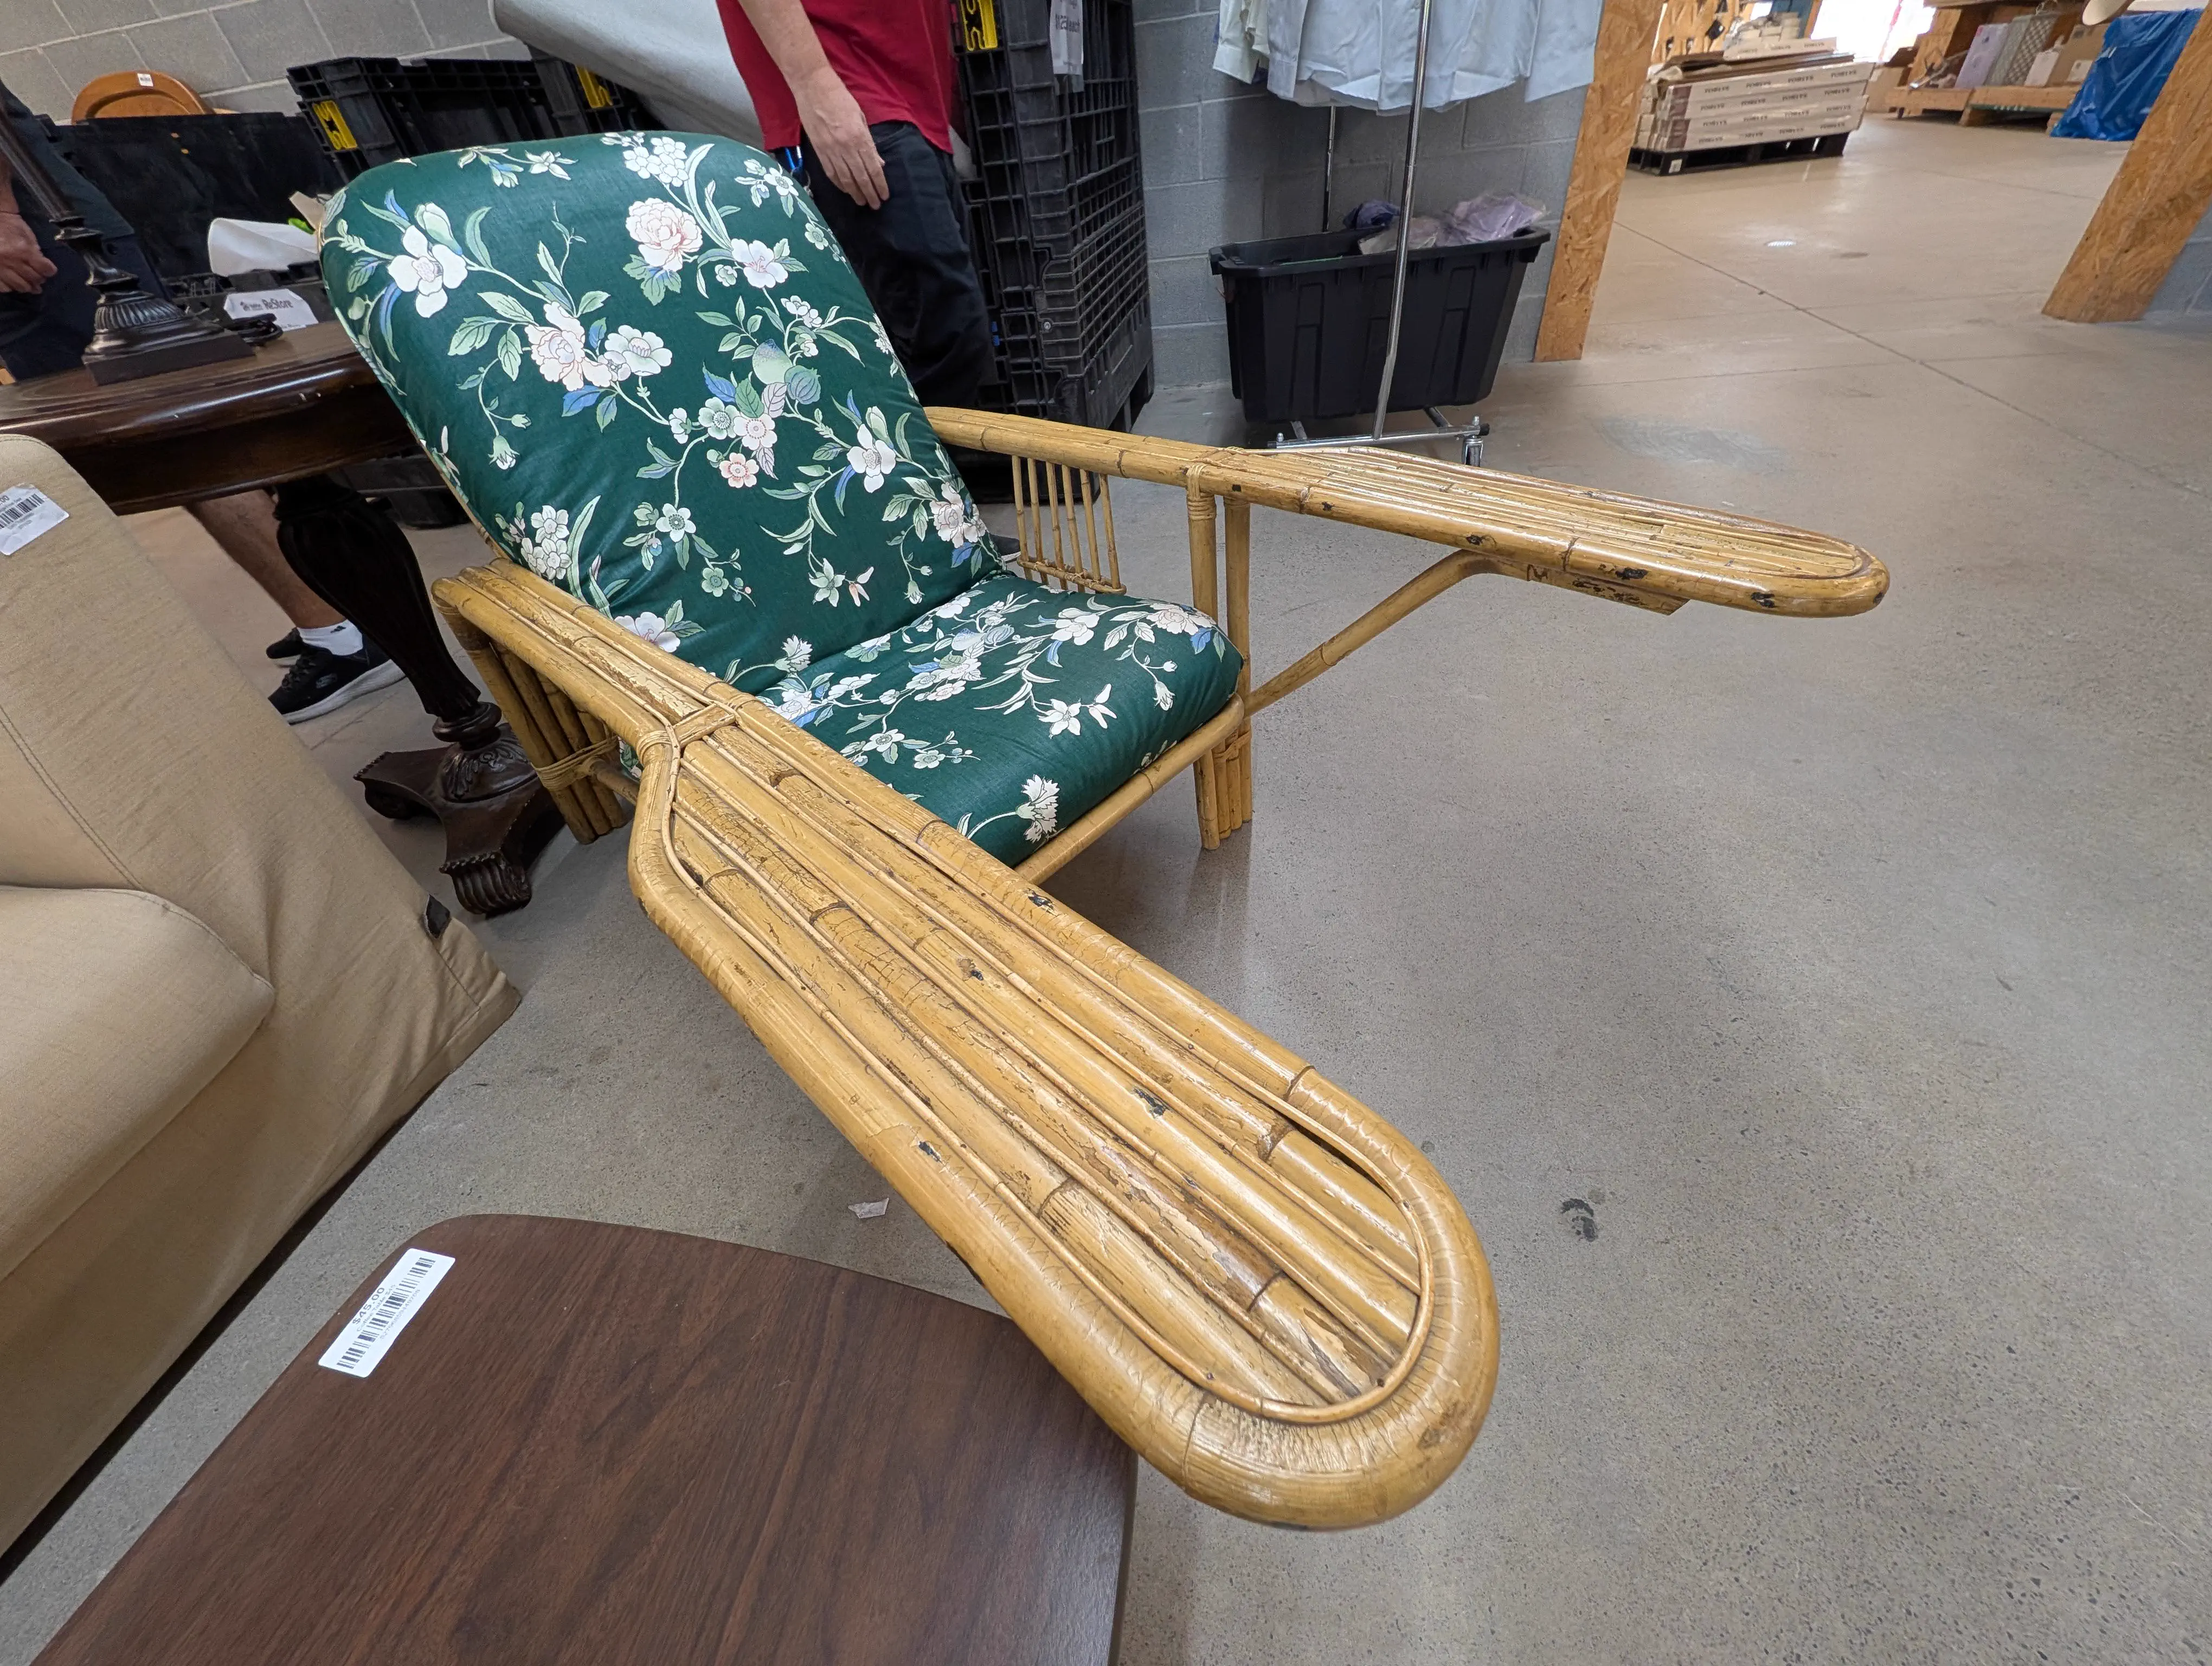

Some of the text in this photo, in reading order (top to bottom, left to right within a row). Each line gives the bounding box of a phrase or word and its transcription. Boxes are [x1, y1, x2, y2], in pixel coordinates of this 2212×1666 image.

[262, 299, 293, 309] ReStore
[352, 1287, 385, 1324] $45.00
[357, 1312, 374, 1331] Coffee
[372, 1297, 386, 1311] Table
